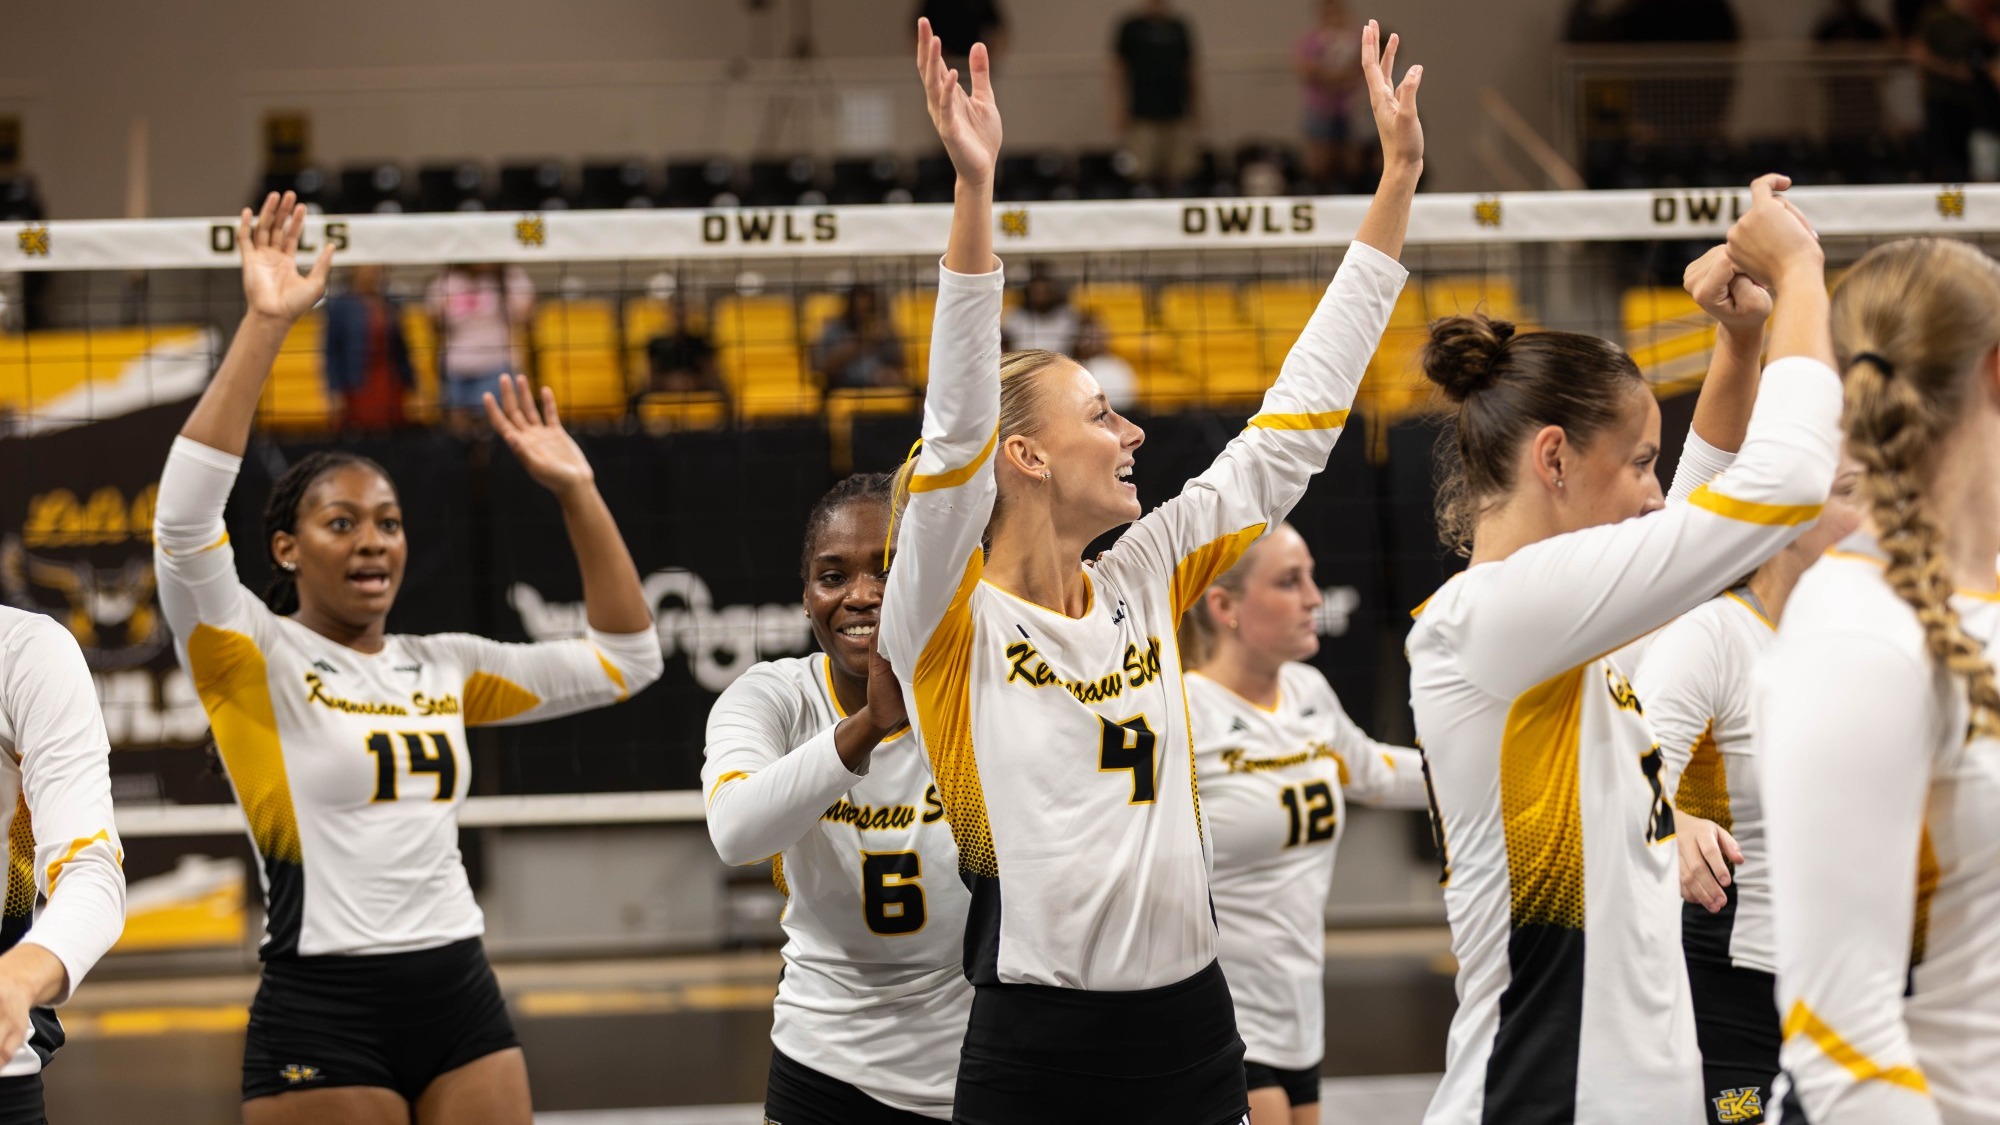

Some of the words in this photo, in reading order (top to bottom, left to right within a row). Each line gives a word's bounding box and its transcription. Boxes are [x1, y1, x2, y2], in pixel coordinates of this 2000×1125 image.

[702, 212, 838, 243] OWLS
[1182, 203, 1315, 234] OWLS
[1653, 196, 1743, 223] OWL
[210, 222, 348, 252] OLS
[364, 729, 459, 804] 14
[1098, 712, 1158, 805] 4
[1280, 779, 1338, 851] 12
[860, 848, 929, 938] 6
